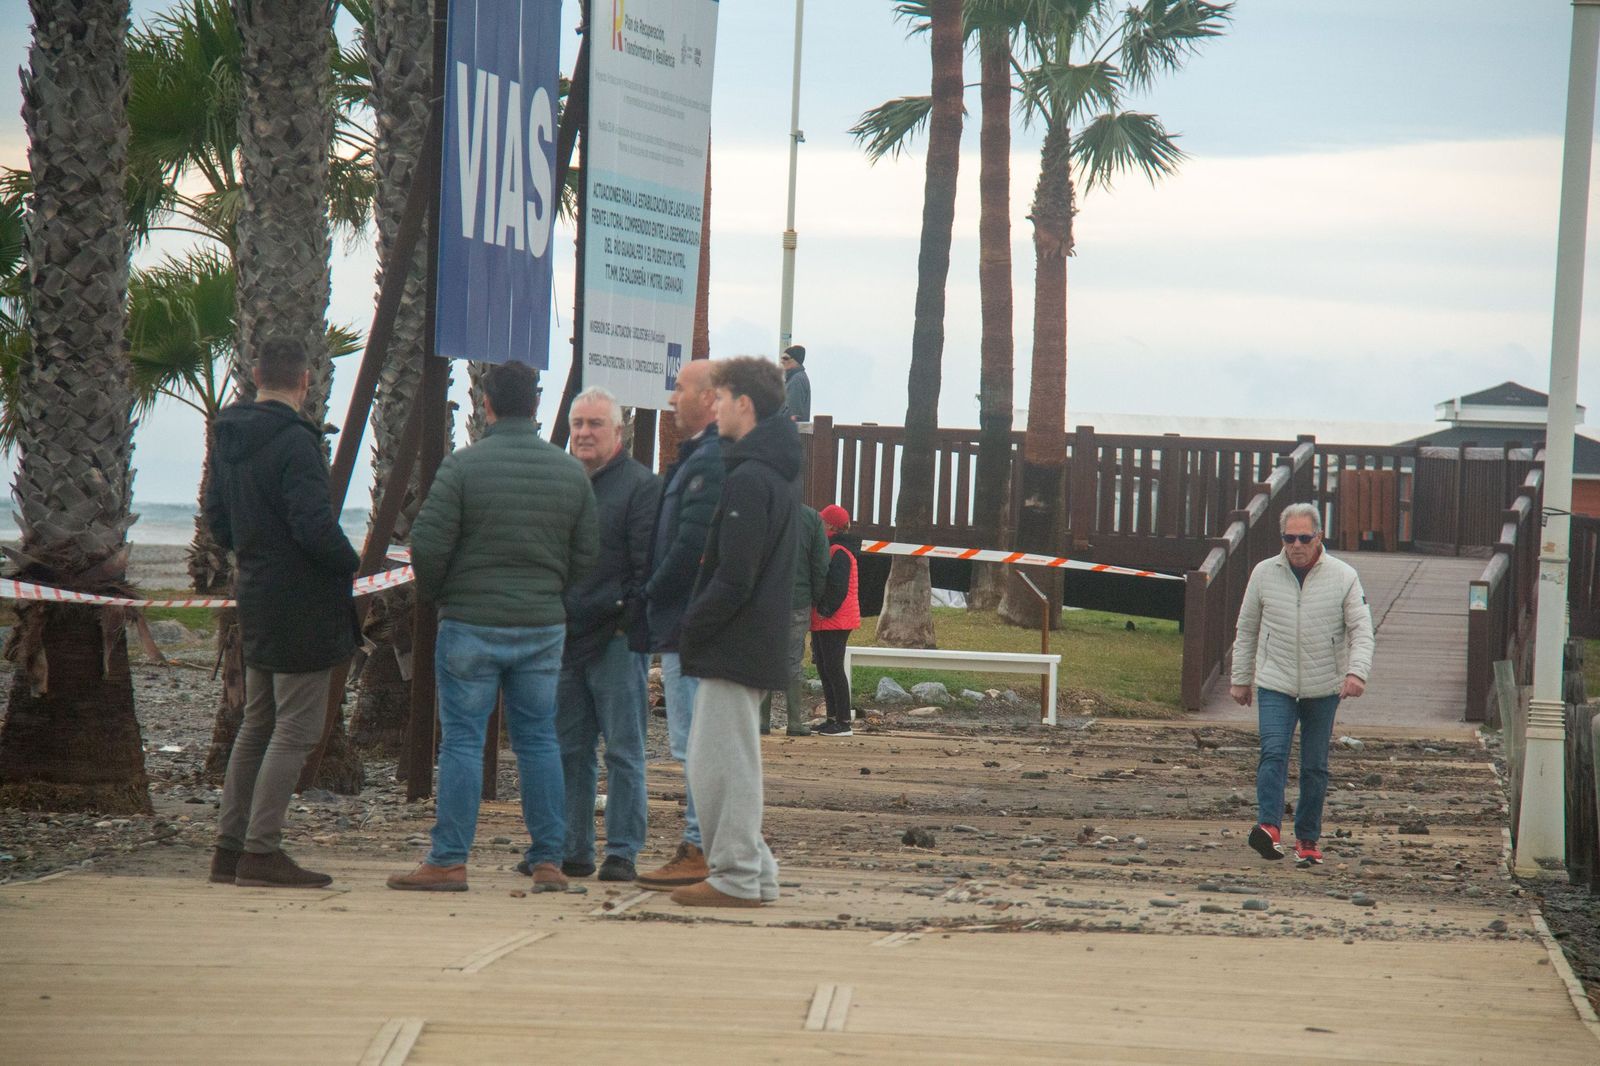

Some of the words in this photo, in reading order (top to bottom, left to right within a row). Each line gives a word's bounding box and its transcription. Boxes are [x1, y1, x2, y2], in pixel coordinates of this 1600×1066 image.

[625, 14, 633, 31] Plan
[634, 18, 639, 33] de
[655, 48, 675, 68] Resiliencia
[457, 62, 552, 258] VIAS
[593, 182, 620, 204] ACTUACIONES
[622, 188, 631, 206] PARA
[633, 191, 637, 208] LA
[668, 199, 674, 216] DE
[592, 208, 606, 227] FRENTE
[607, 211, 624, 230] LITORAL
[652, 221, 664, 239] ENTRE
[647, 246, 651, 262] EL
[652, 247, 666, 265] PUERTO
[667, 250, 671, 266] DE
[619, 266, 624, 283] DE
[650, 272, 663, 290] MOTRIL
